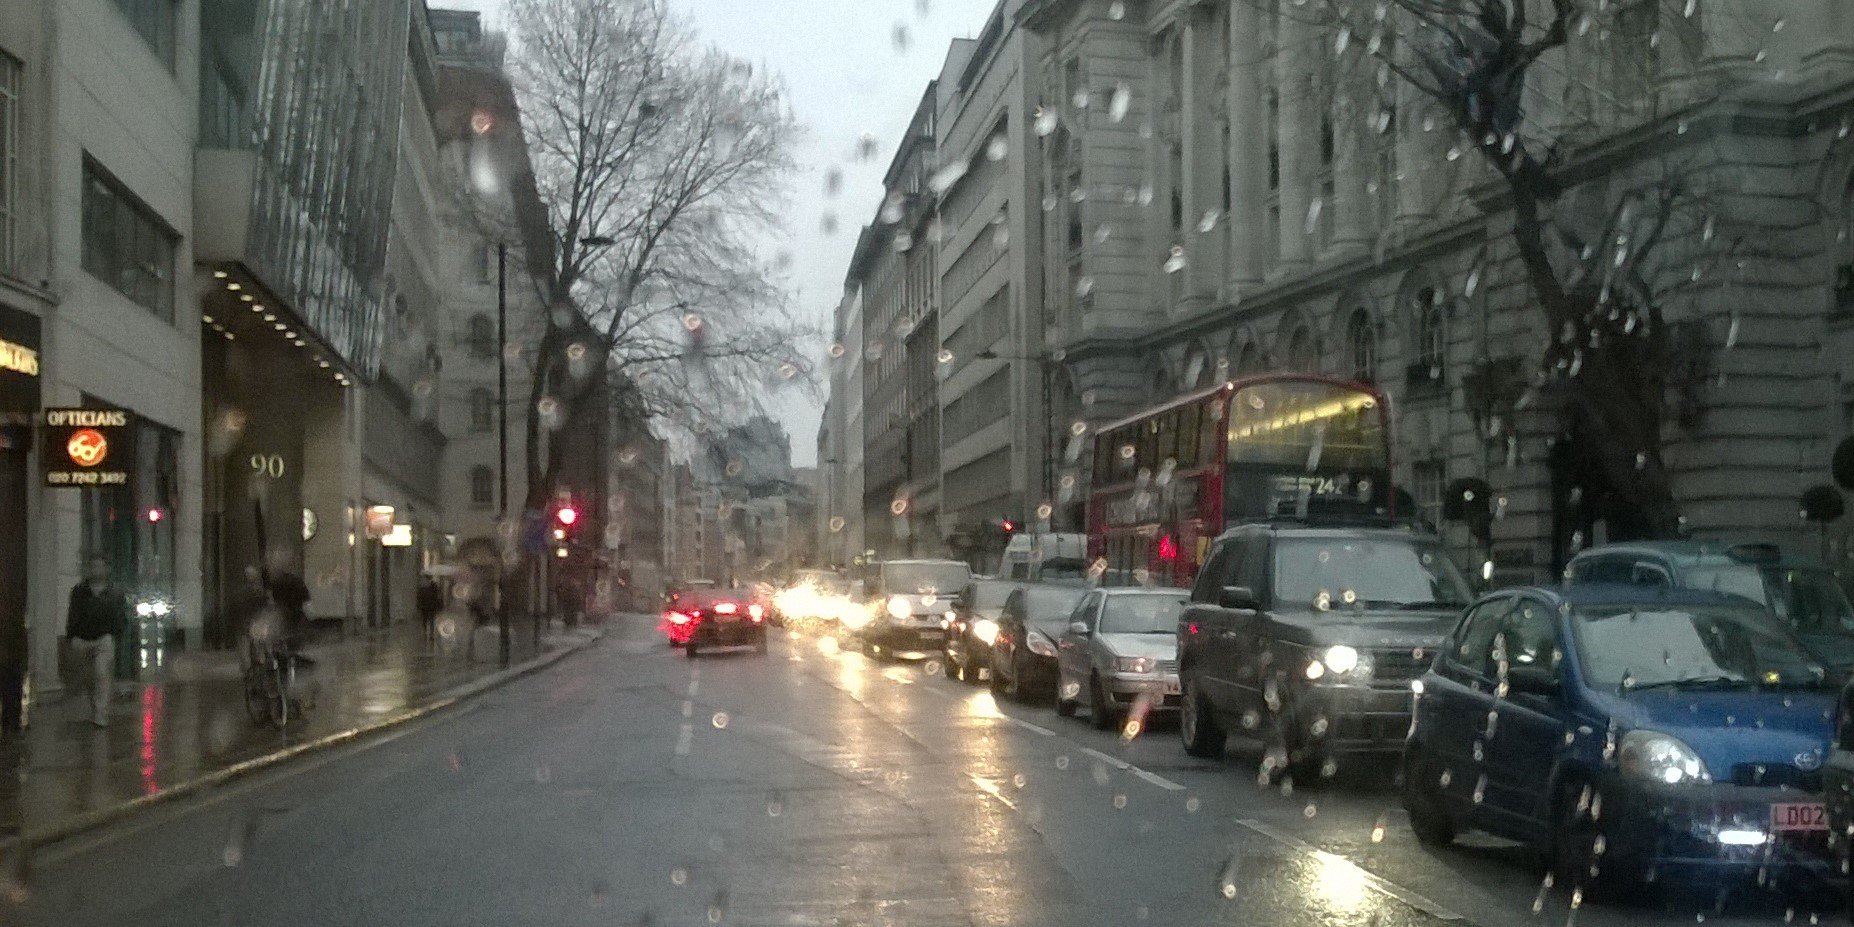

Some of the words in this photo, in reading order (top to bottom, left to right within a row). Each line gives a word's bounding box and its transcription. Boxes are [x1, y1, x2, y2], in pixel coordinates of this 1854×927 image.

[47, 410, 126, 427] OPTICIANS
[250, 453, 285, 478] 90
[1773, 805, 1825, 826] LD02
